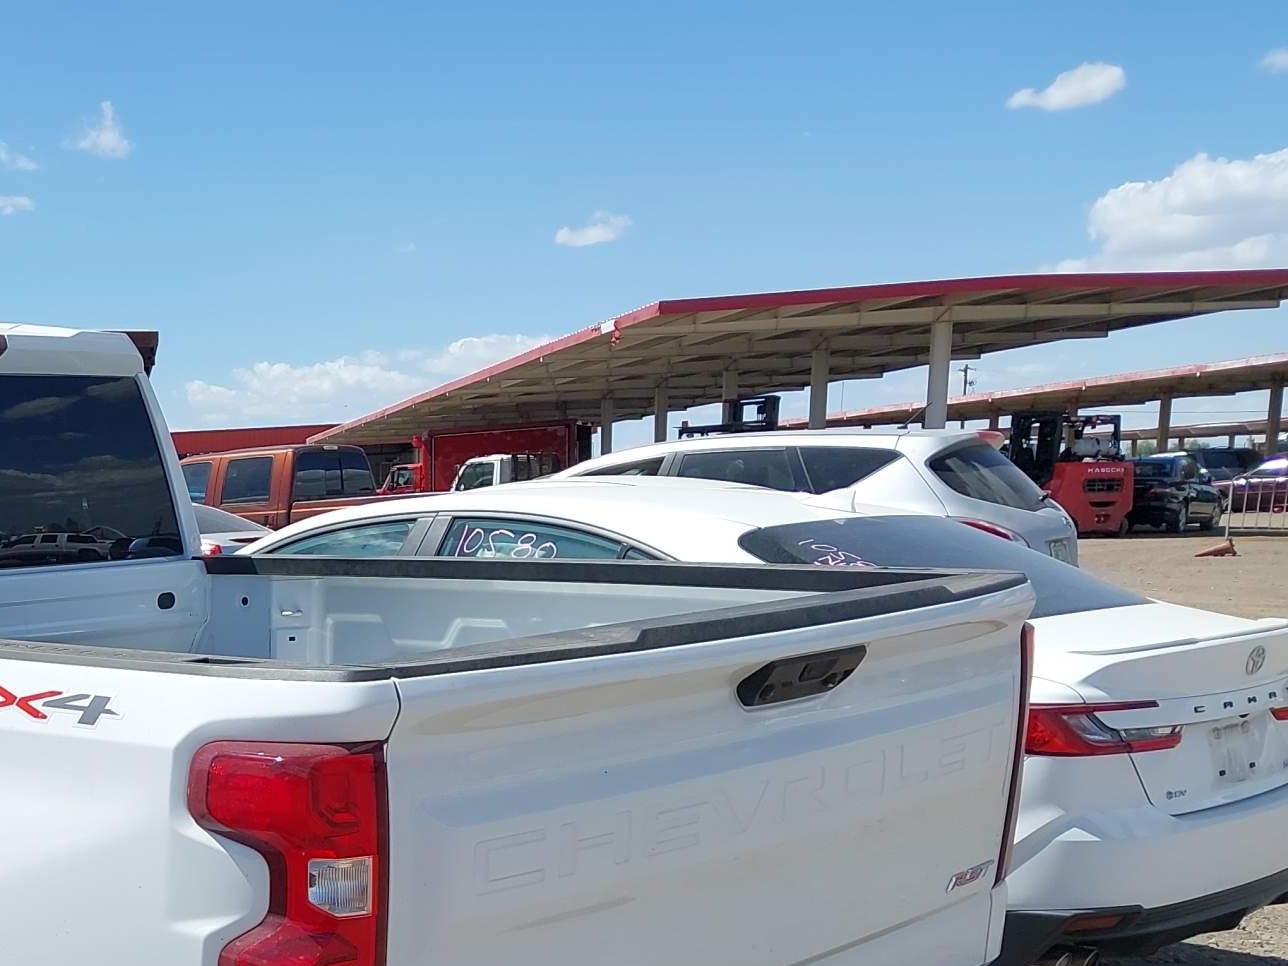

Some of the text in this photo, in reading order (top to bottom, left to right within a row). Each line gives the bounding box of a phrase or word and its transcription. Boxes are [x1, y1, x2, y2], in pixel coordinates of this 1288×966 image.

[1193, 687, 1288, 714] CAMR
[474, 722, 1010, 896] CHEVROLET
[945, 859, 995, 894] RST
